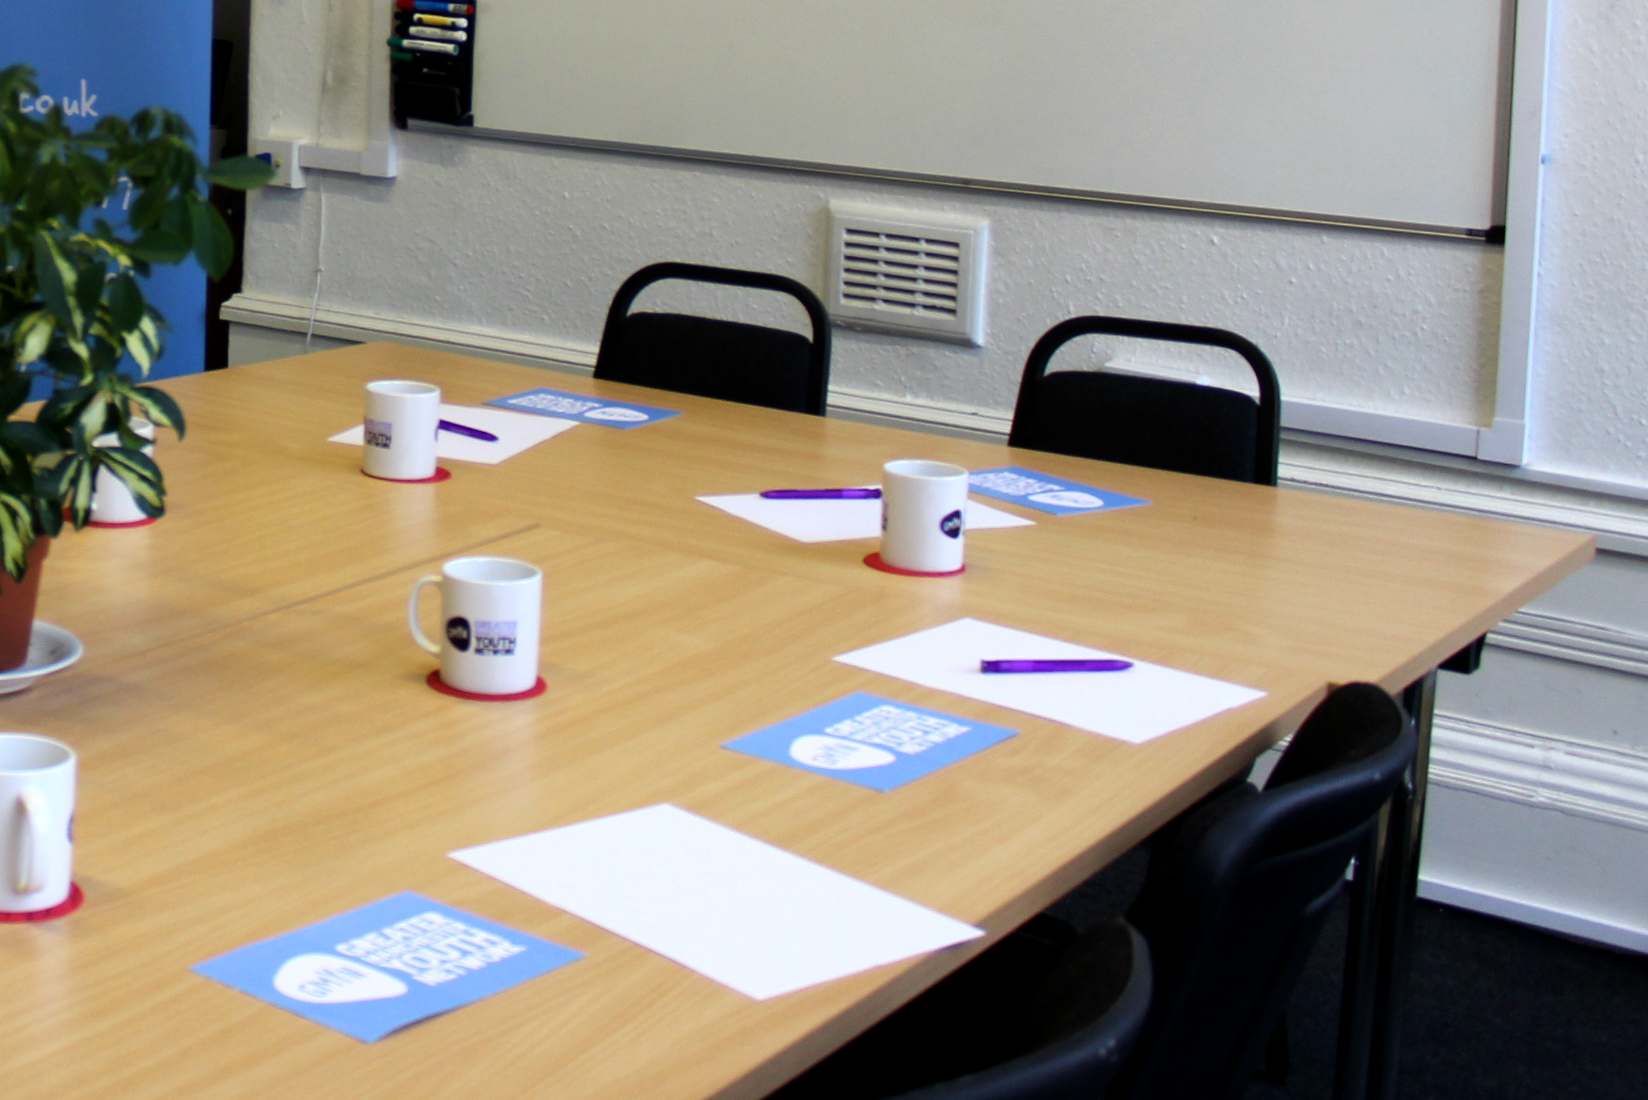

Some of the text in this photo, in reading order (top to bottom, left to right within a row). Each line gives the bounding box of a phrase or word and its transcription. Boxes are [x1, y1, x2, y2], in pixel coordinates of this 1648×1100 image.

[476, 636, 516, 649] YOUTH
[334, 911, 448, 957] GREATER
[378, 927, 505, 977] YOUTH
[298, 967, 369, 999] GMYN
[412, 943, 529, 987] NETWORK
